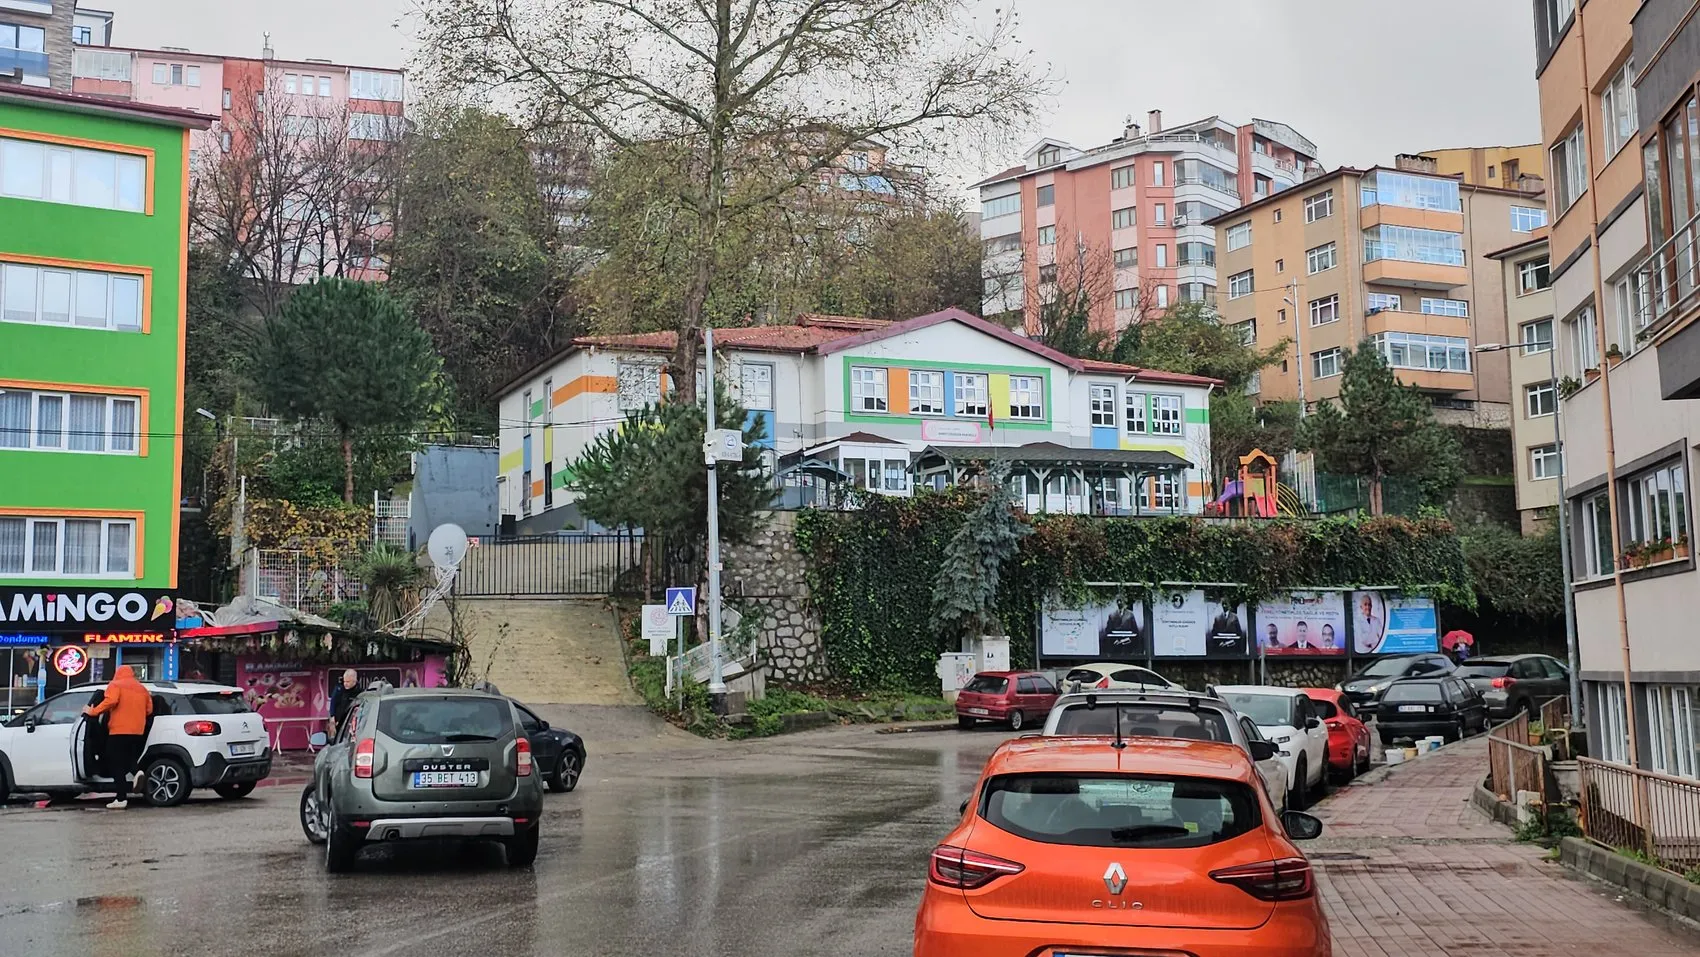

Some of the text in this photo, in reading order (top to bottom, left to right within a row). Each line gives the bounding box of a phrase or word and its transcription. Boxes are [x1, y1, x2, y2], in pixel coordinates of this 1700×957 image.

[0, 592, 148, 622] MiNGO
[421, 773, 476, 784] 35 BET 413
[1091, 899, 1143, 910] CLIO
